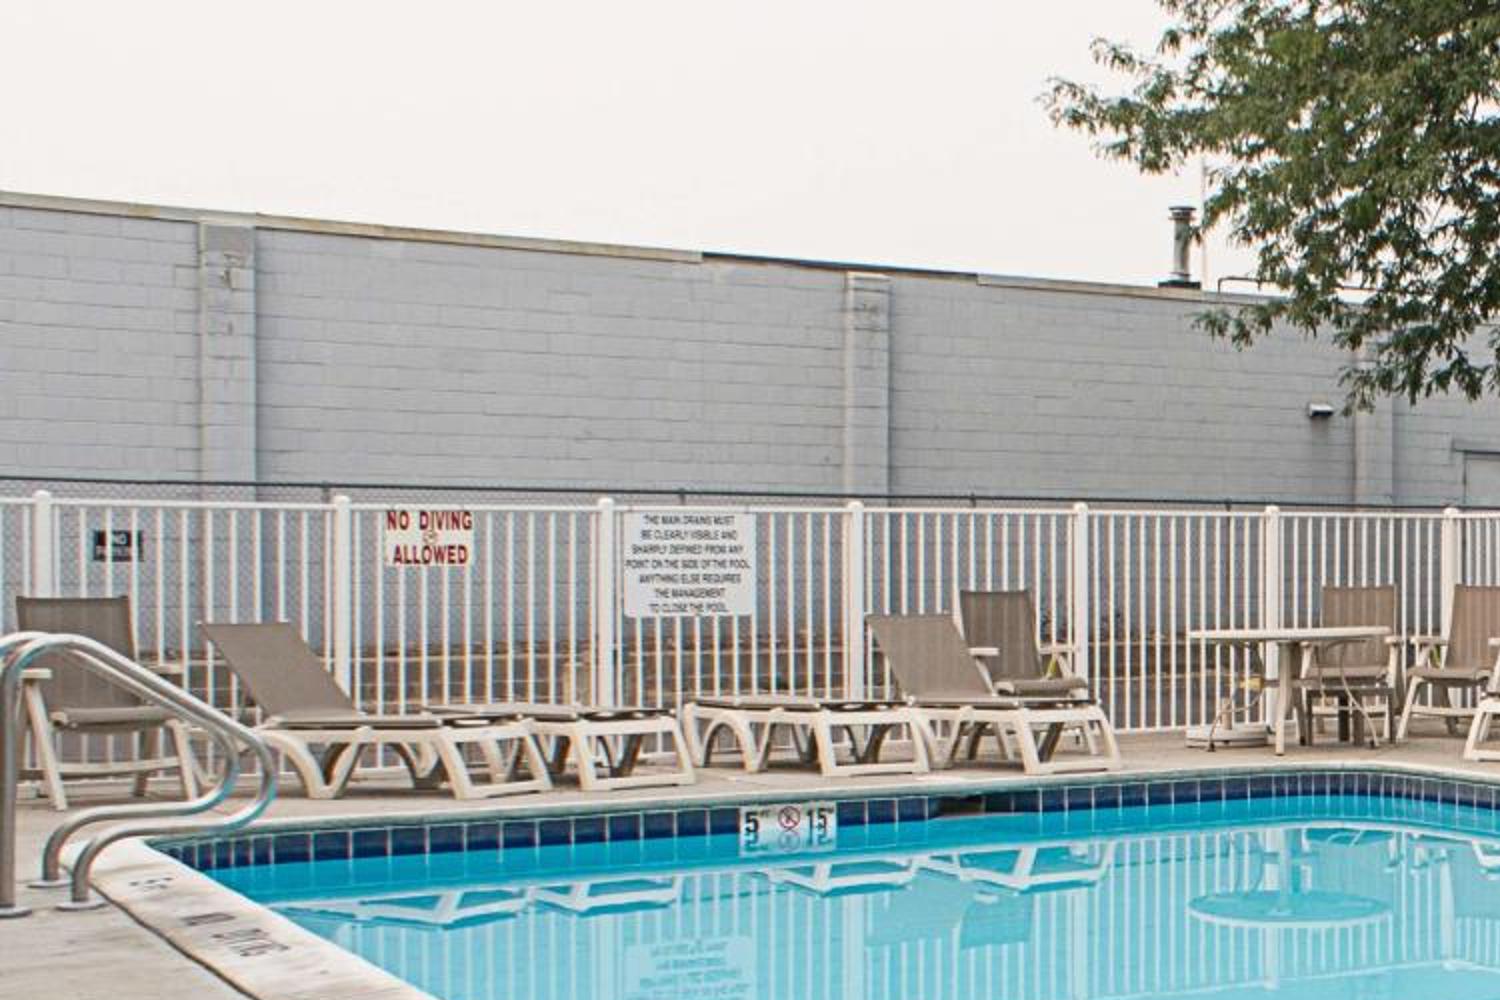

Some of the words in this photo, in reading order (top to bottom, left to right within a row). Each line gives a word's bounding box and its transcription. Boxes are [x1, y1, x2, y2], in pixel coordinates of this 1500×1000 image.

[387, 511, 410, 530] NO
[419, 511, 472, 530] DIVING
[393, 545, 468, 564] ALLOWED
[745, 811, 760, 832] 5
